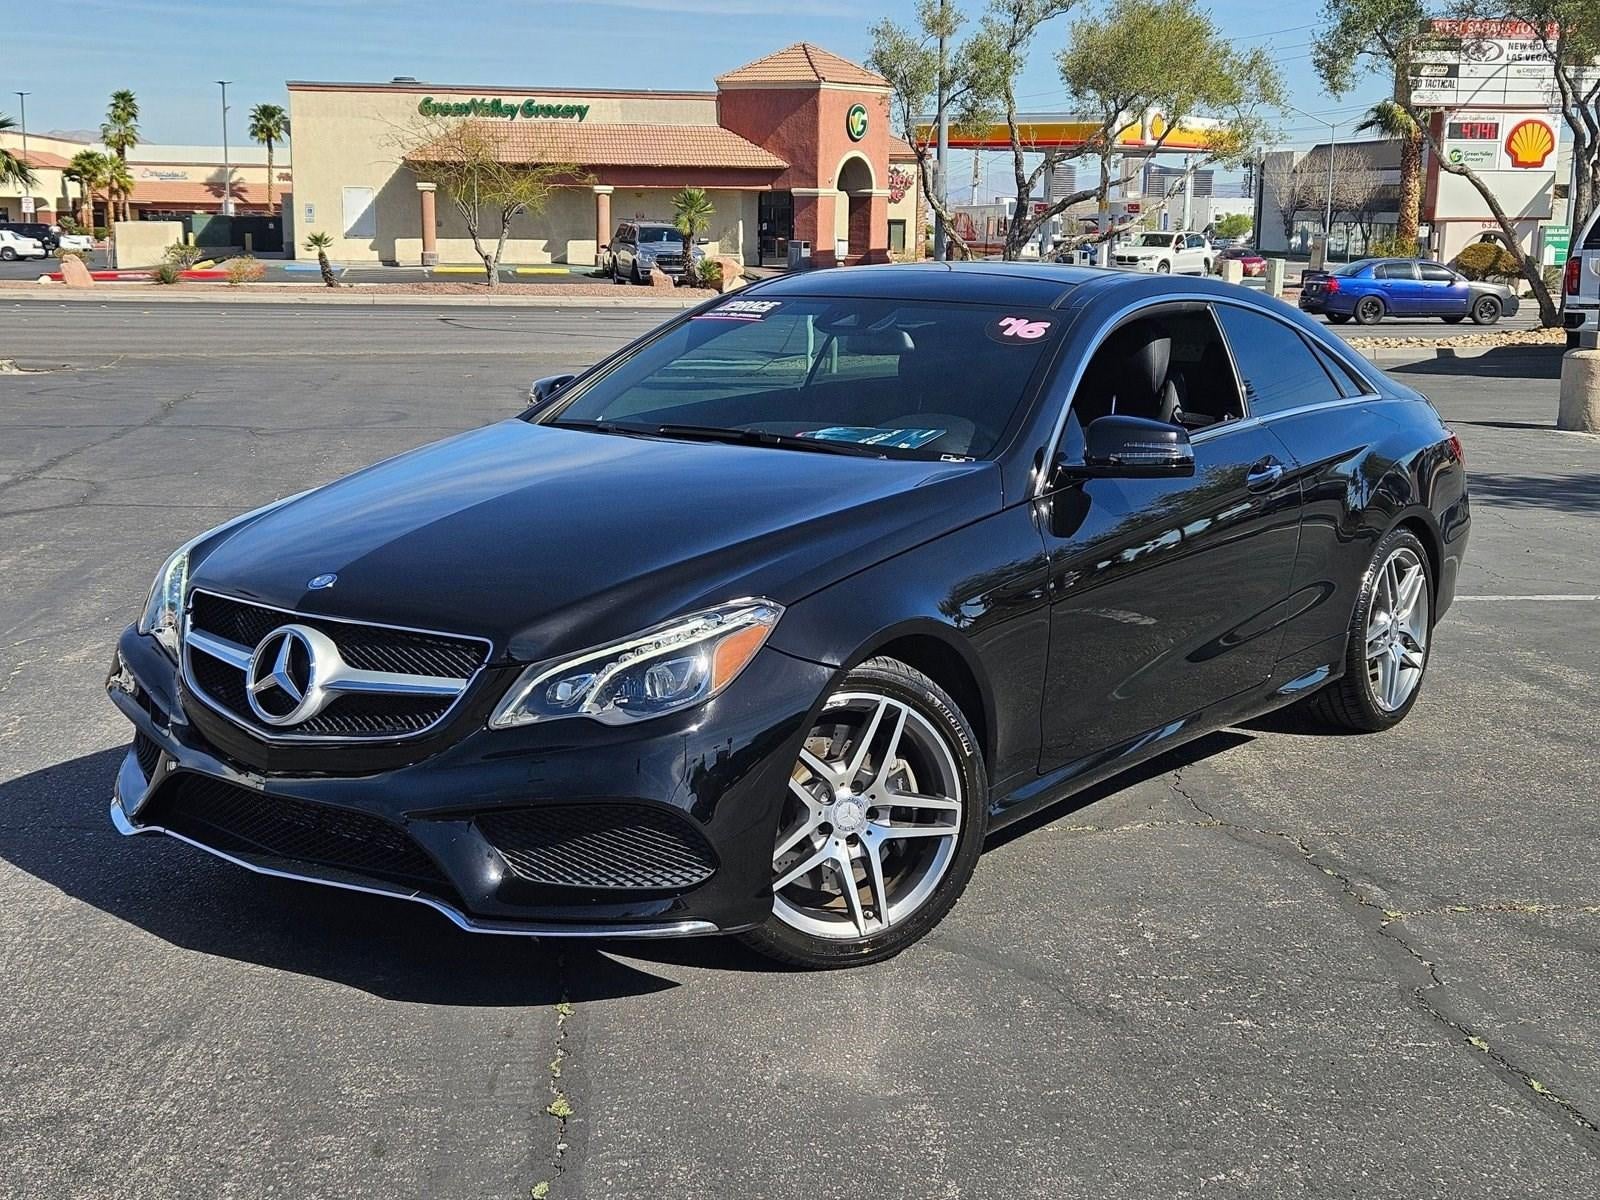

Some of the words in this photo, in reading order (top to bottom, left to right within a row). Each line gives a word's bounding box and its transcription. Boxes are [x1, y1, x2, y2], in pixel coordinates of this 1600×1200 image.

[1508, 42, 1527, 50] NEW
[1506, 53, 1522, 61] LAS
[1424, 79, 1456, 88] TACTICAL
[519, 98, 590, 123] Grocery
[936, 702, 973, 756] MICHELIN
